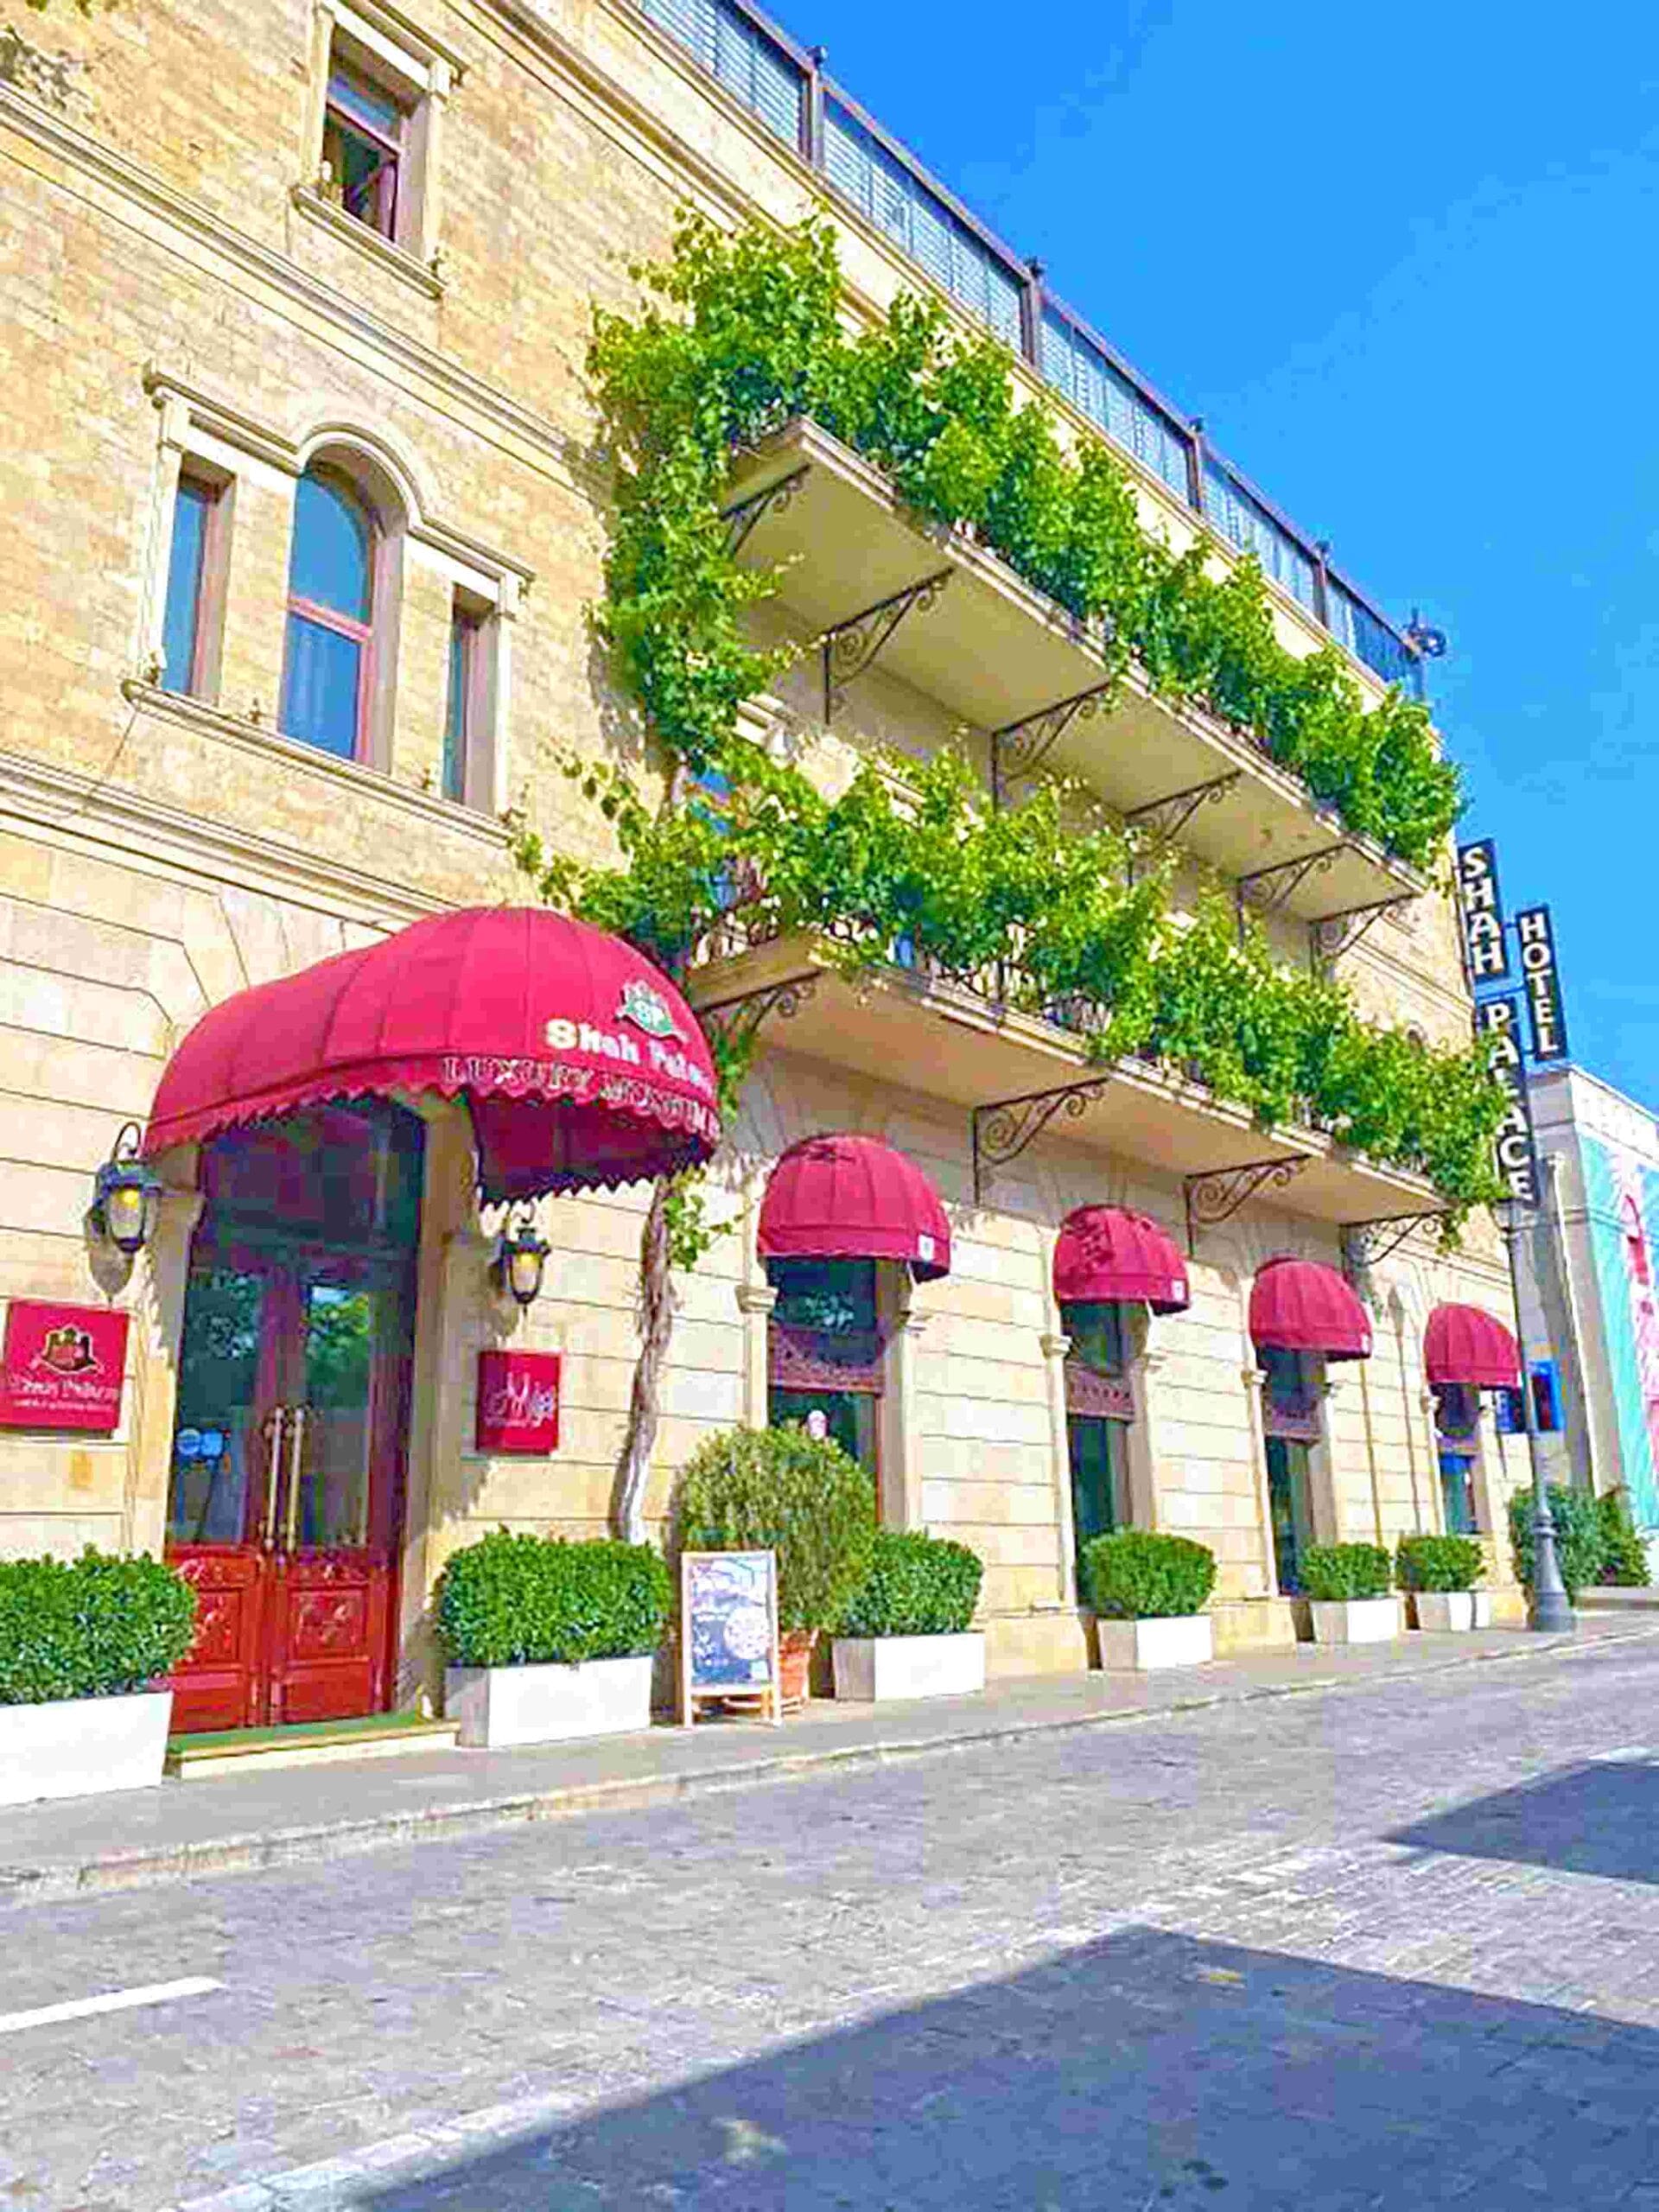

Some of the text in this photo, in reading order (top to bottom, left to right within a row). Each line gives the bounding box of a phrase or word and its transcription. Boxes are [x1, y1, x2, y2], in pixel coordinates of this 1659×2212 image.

[1462, 847, 1504, 976] SHAH
[546, 1018, 640, 1065] Shah
[1521, 912, 1560, 1052] HOTEL
